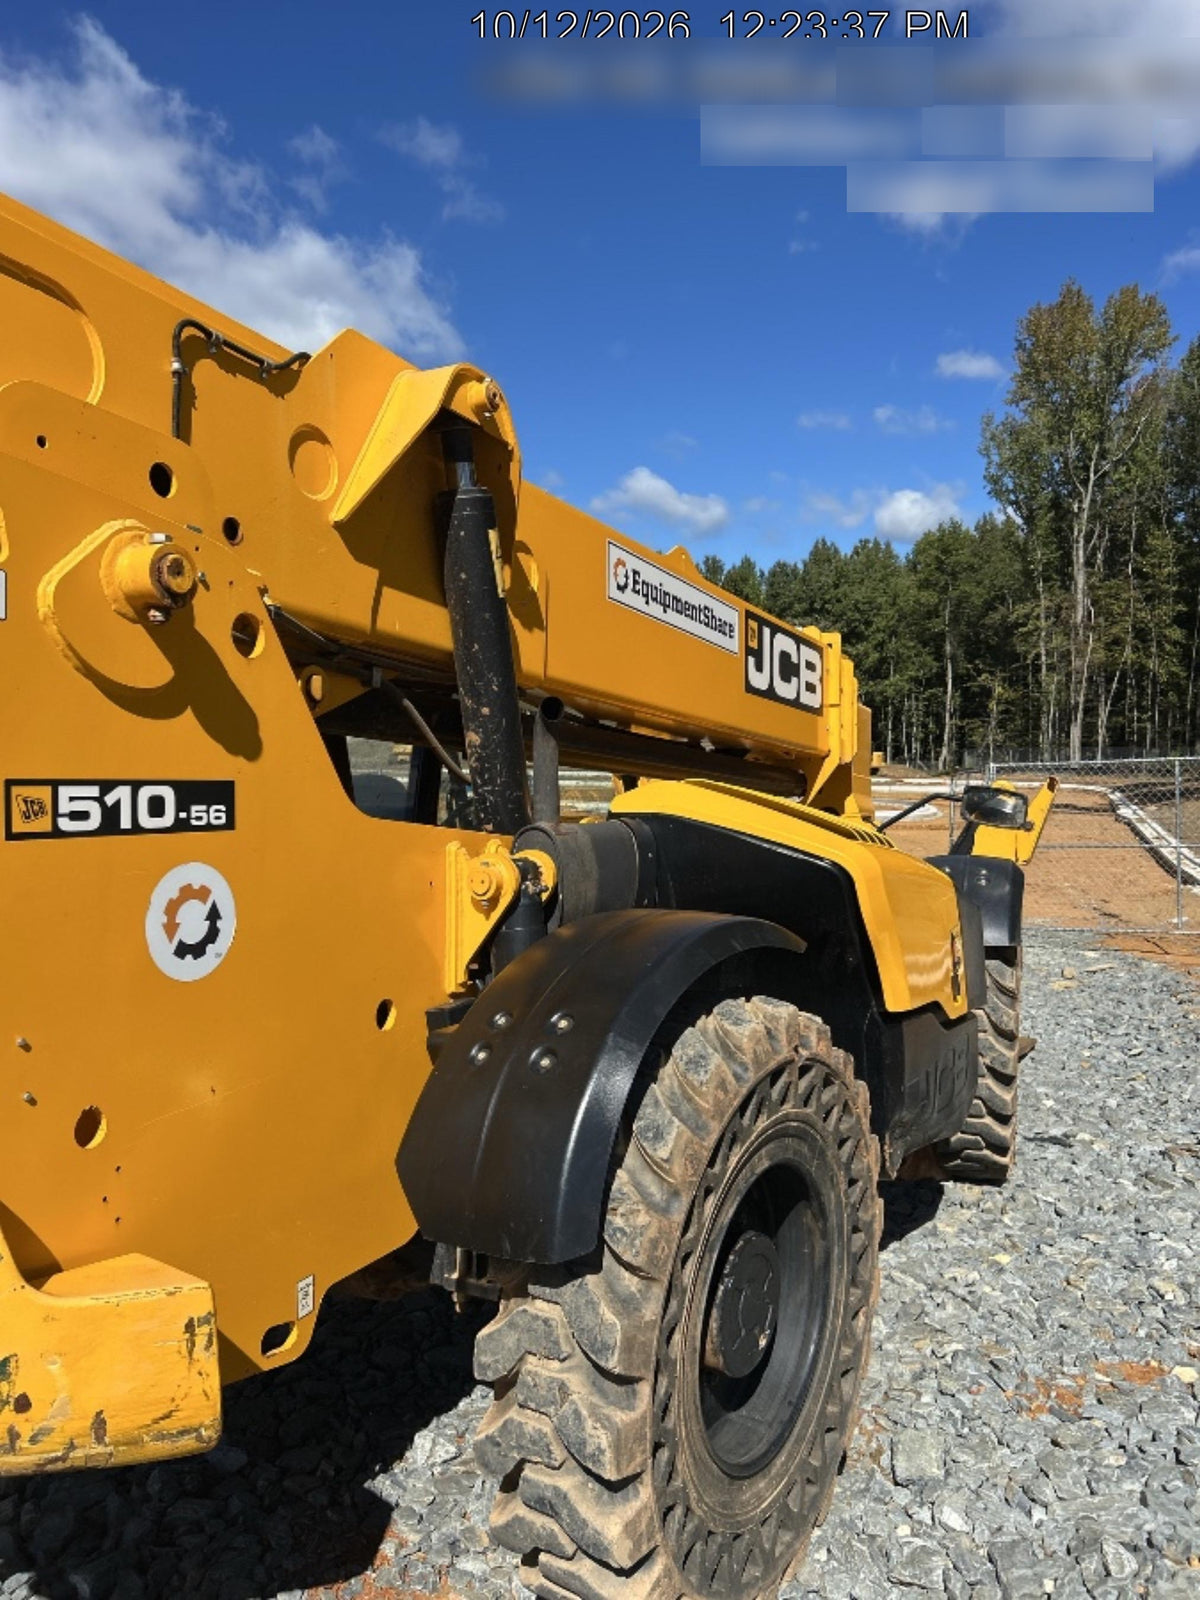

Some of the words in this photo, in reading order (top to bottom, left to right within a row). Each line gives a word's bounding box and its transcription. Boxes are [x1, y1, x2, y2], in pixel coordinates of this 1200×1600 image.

[631, 568, 735, 640] EquipmentShare
[747, 625, 823, 709] JCB
[21, 797, 47, 822] JCB
[56, 785, 227, 832] 510-56
